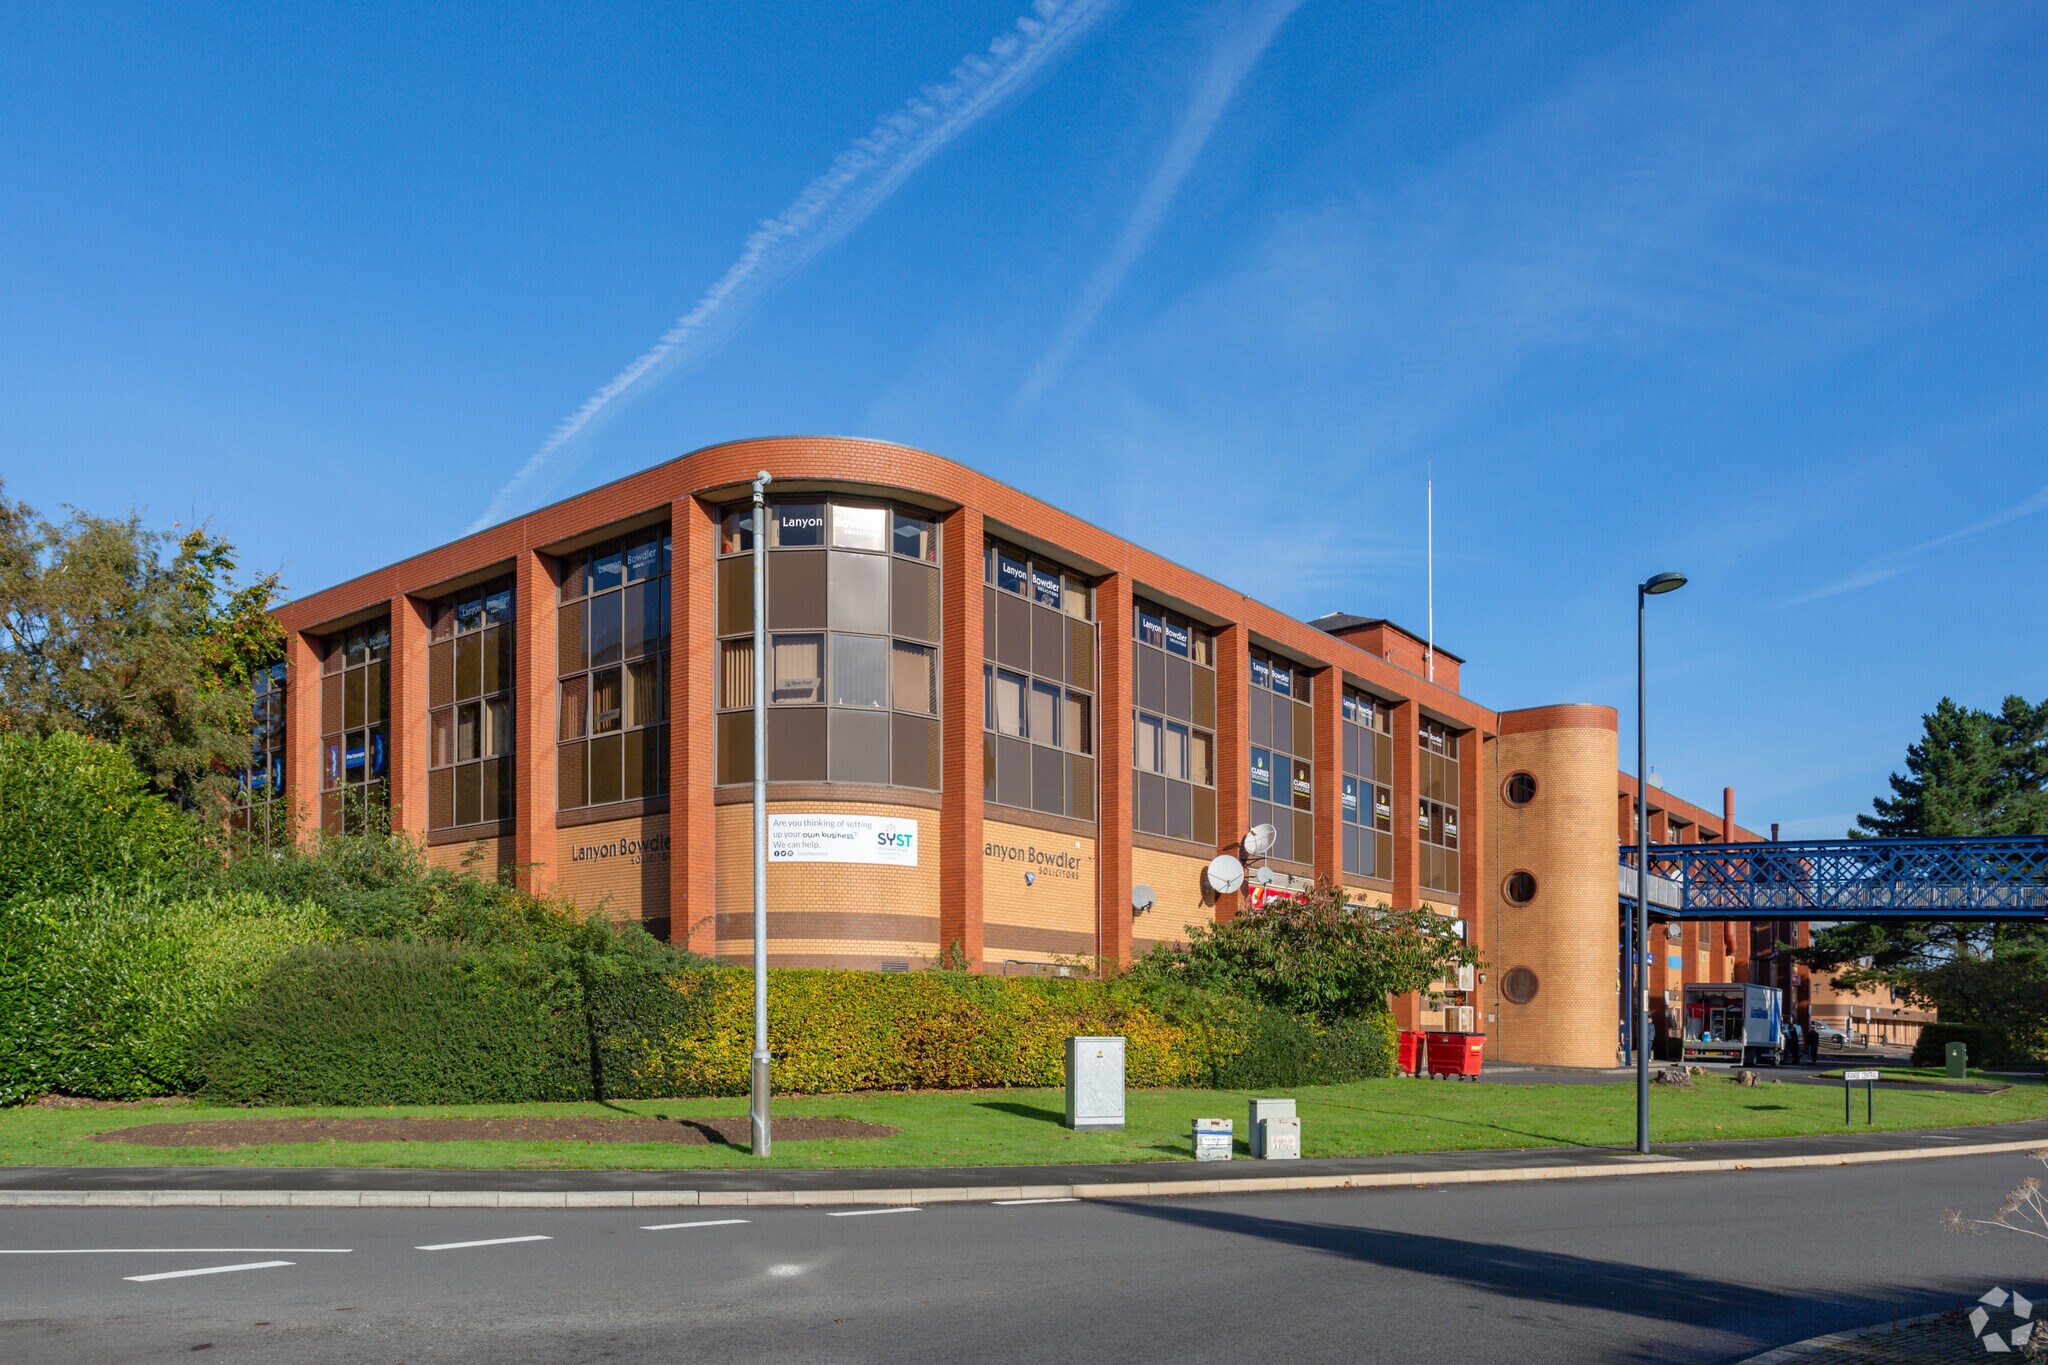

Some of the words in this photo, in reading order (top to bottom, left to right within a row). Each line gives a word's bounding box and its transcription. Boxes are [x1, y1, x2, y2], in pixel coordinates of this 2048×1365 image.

[782, 516, 823, 529] Lanyon
[627, 549, 656, 565] Bowdler
[1002, 562, 1027, 580] Lanyon
[1032, 574, 1060, 592] Bowdler
[1142, 618, 1162, 633] Lanyon
[1165, 627, 1188, 642] Bowdler
[1251, 766, 1269, 778] CLARKES
[773, 819, 787, 827] Are
[803, 819, 836, 829] thinking
[836, 820, 845, 828] of
[845, 821, 873, 831] setting
[773, 832, 782, 840] up
[783, 832, 801, 841] your
[821, 831, 857, 840] business?
[877, 832, 913, 848] SYST
[572, 844, 617, 863] Lanyon
[620, 833, 671, 856] Bowdle
[773, 841, 786, 849] We
[802, 840, 821, 850] help.
[984, 842, 1025, 862] anyon
[1028, 846, 1081, 870] Bowdler
[1038, 866, 1079, 880] SOLICITORS
